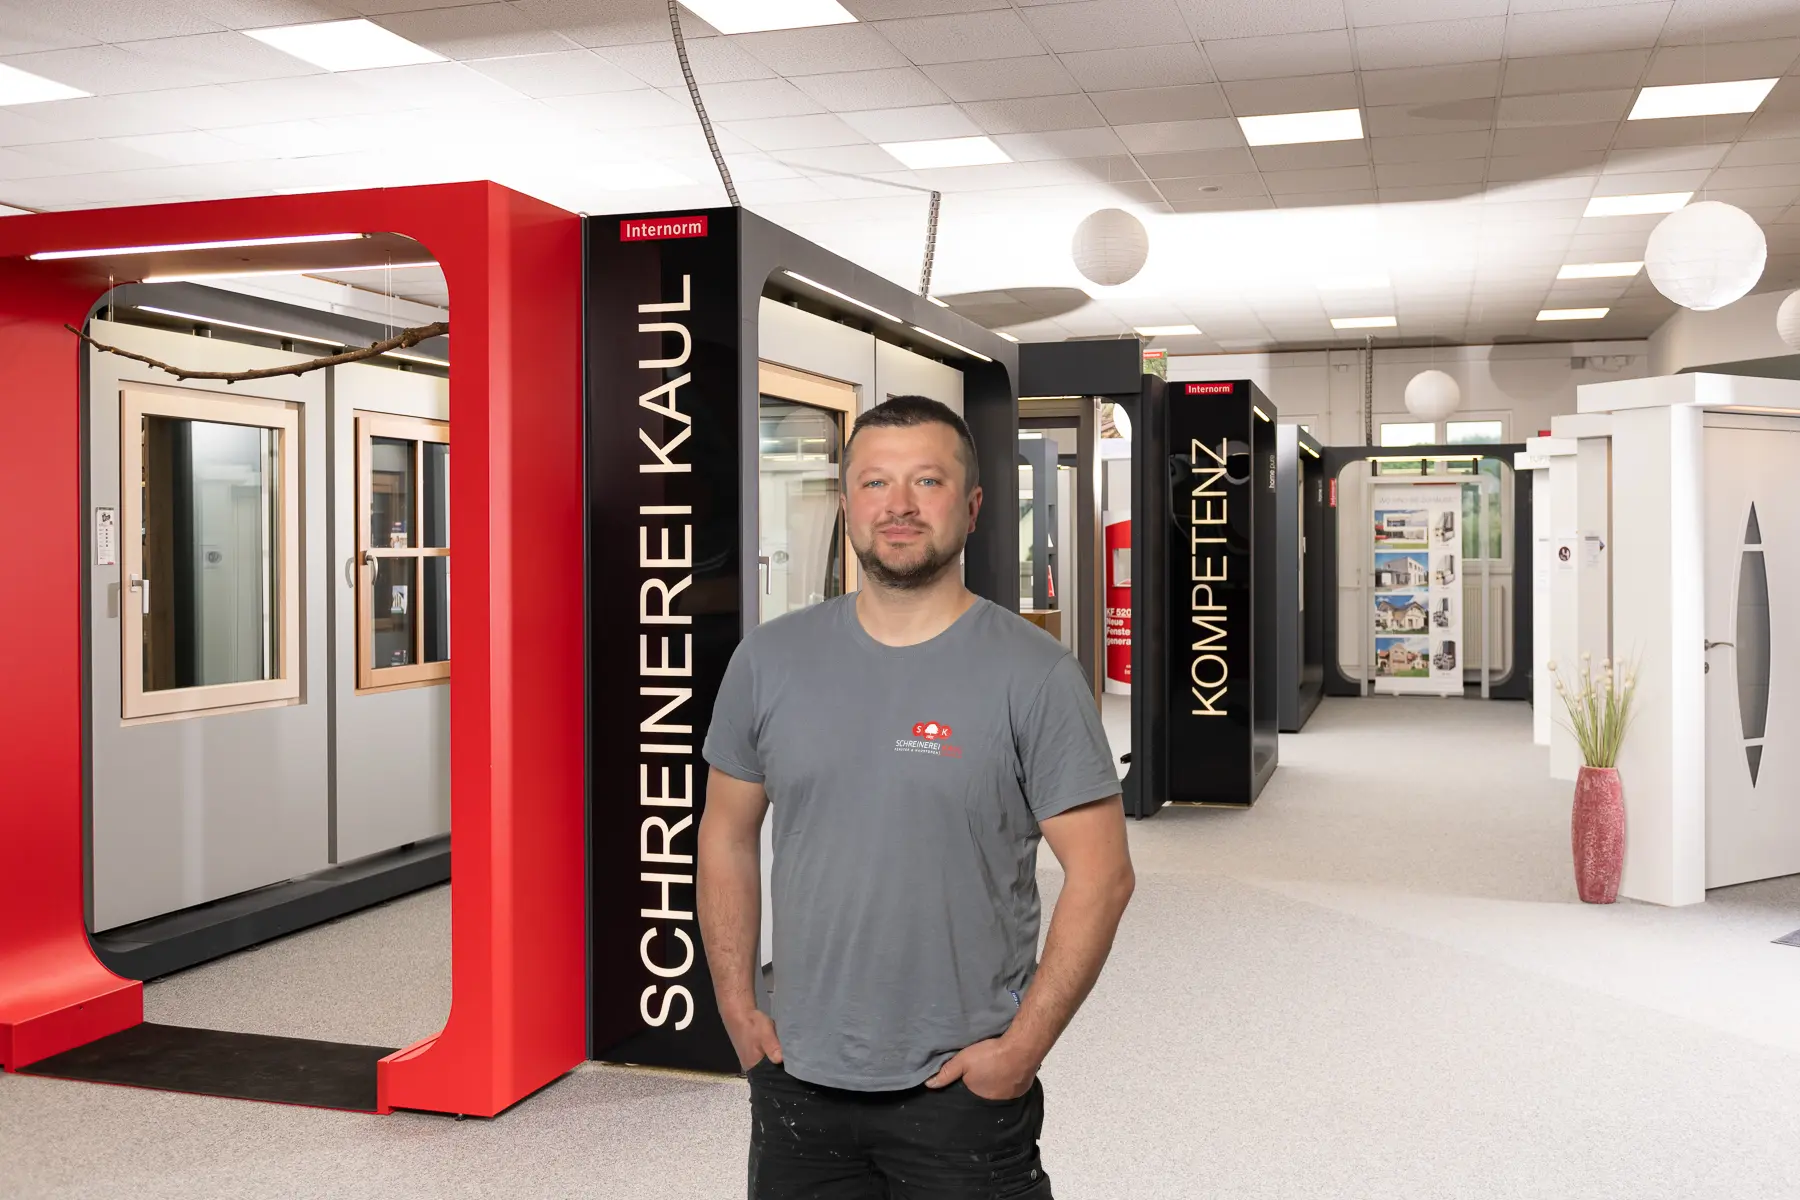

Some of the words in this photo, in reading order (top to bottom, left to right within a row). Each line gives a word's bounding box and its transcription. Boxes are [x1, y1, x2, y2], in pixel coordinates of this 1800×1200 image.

[626, 221, 702, 238] Internorm
[638, 274, 692, 473] KAUL
[1188, 385, 1230, 394] Internorm
[1191, 437, 1228, 716] KOMPETENZ
[1116, 608, 1131, 617] 520
[916, 725, 922, 734] S
[941, 728, 949, 736] K
[895, 740, 941, 750] SCHREINEREI
[639, 505, 694, 1031] SCHREINEREI
